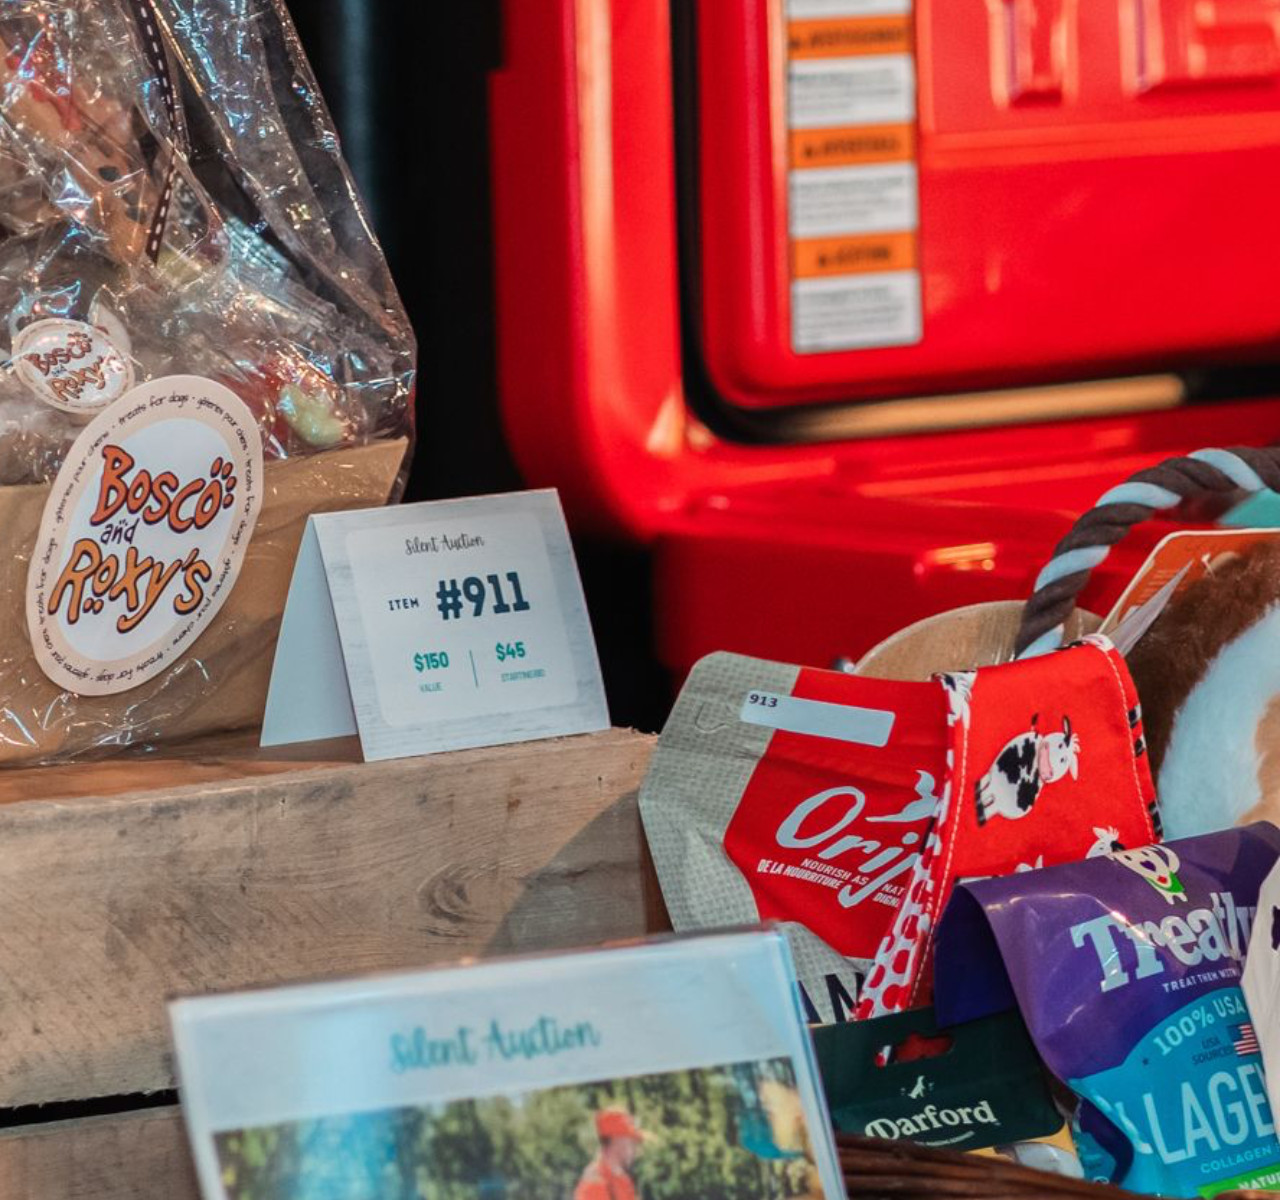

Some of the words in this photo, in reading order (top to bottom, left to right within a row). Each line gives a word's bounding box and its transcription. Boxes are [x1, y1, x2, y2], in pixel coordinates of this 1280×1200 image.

[89, 444, 226, 534] Bosco
[100, 517, 140, 545] and
[405, 536, 440, 556] Silent
[441, 533, 486, 552] Auction
[48, 537, 213, 633] Roxy's
[388, 597, 420, 611] ITEM
[435, 571, 531, 620] #911
[413, 651, 450, 673] $150
[495, 642, 526, 662] $45
[749, 693, 778, 708] 913
[775, 785, 920, 908] Orij
[756, 858, 772, 874] DE
[769, 861, 783, 874] LA
[783, 865, 845, 890] NOURRITURE
[801, 857, 852, 880] NOURISH
[852, 874, 870, 885] AS
[881, 883, 906, 896] NAT
[1162, 976, 1197, 993] TREAT
[390, 1025, 477, 1074] Silent
[480, 1014, 601, 1059] Auction
[1152, 1006, 1214, 1056] 100%
[1211, 995, 1245, 1018] USA
[865, 1100, 997, 1140] Darford
[1200, 1147, 1272, 1175] COLLAGEN
